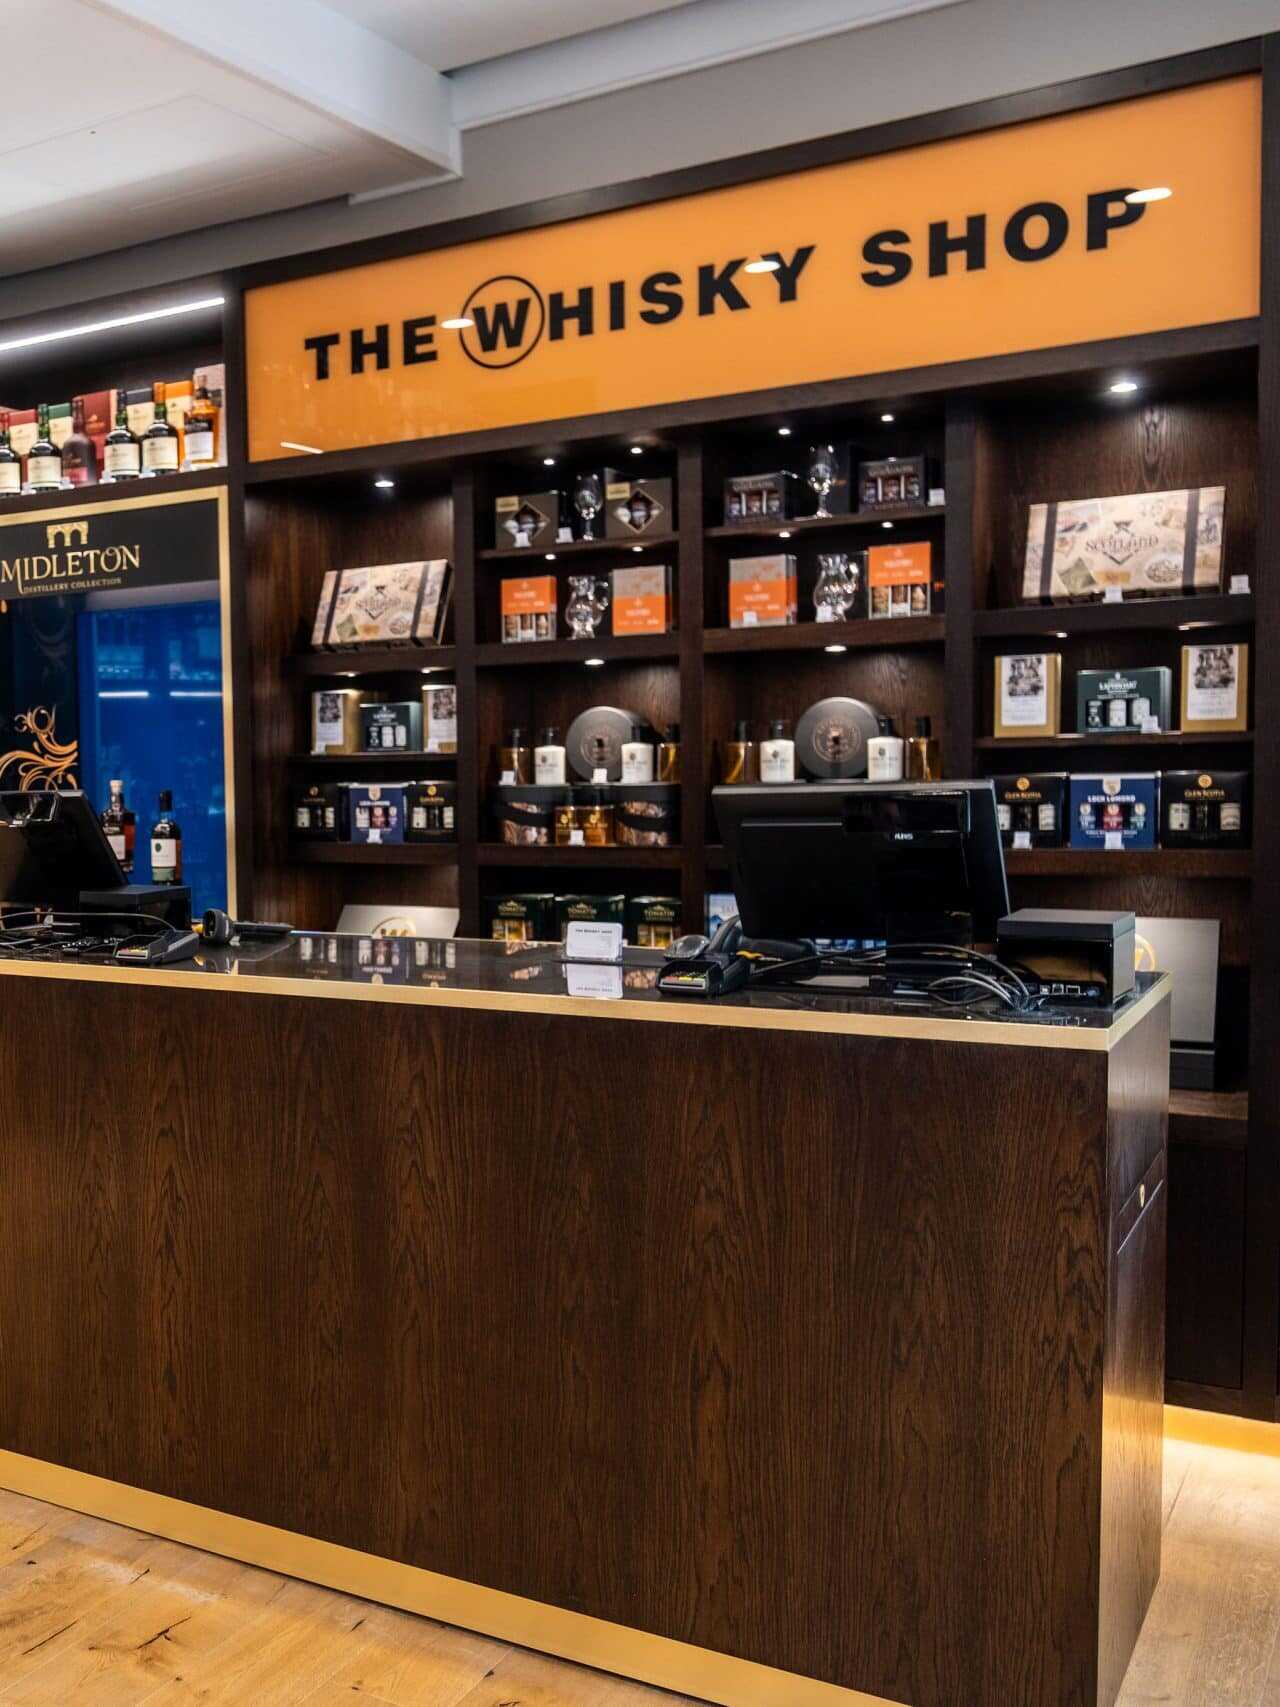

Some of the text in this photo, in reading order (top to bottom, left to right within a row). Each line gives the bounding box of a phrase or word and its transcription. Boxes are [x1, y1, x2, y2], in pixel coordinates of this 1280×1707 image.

[305, 186, 1146, 381] THE WHISKY SHOP
[1, 545, 140, 591] MIDLETON
[23, 577, 122, 593] DISTILLERY COLLECTION
